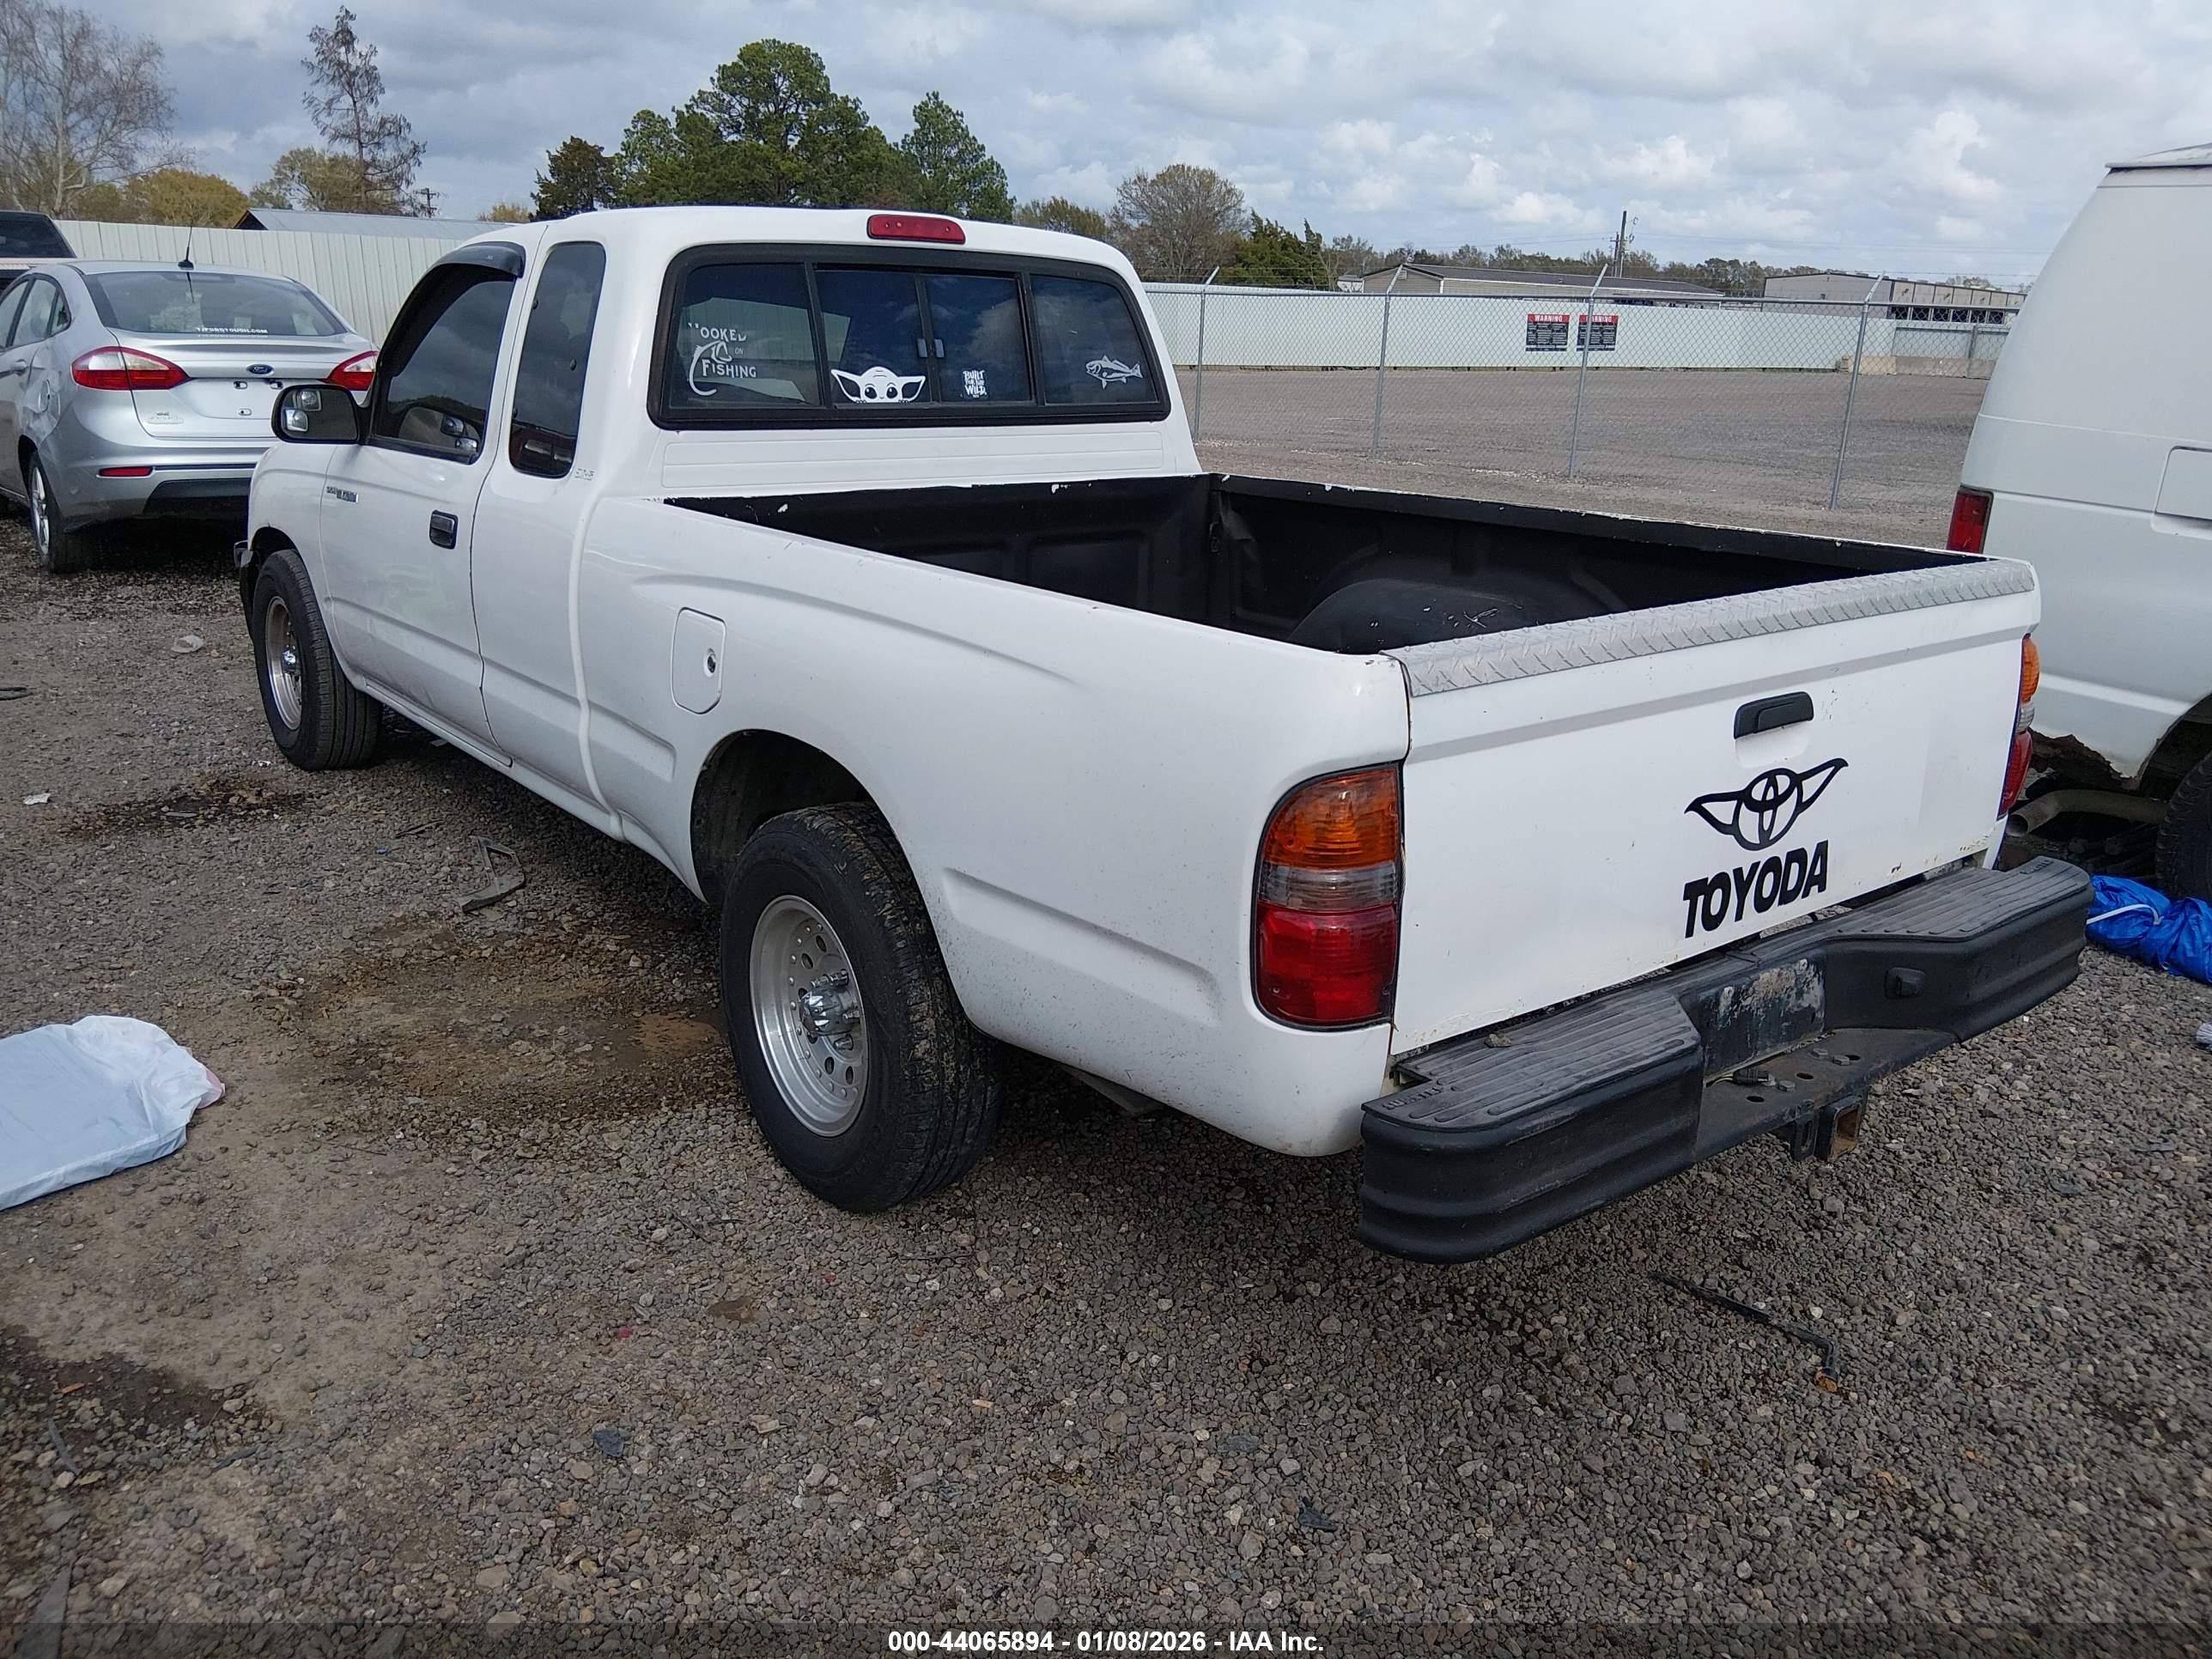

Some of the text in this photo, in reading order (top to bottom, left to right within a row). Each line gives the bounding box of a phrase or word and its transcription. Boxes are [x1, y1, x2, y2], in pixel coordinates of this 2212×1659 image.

[702, 359, 757, 379] FISHING
[963, 369, 985, 380] BUILT
[1682, 839, 1829, 939] TOYODA
